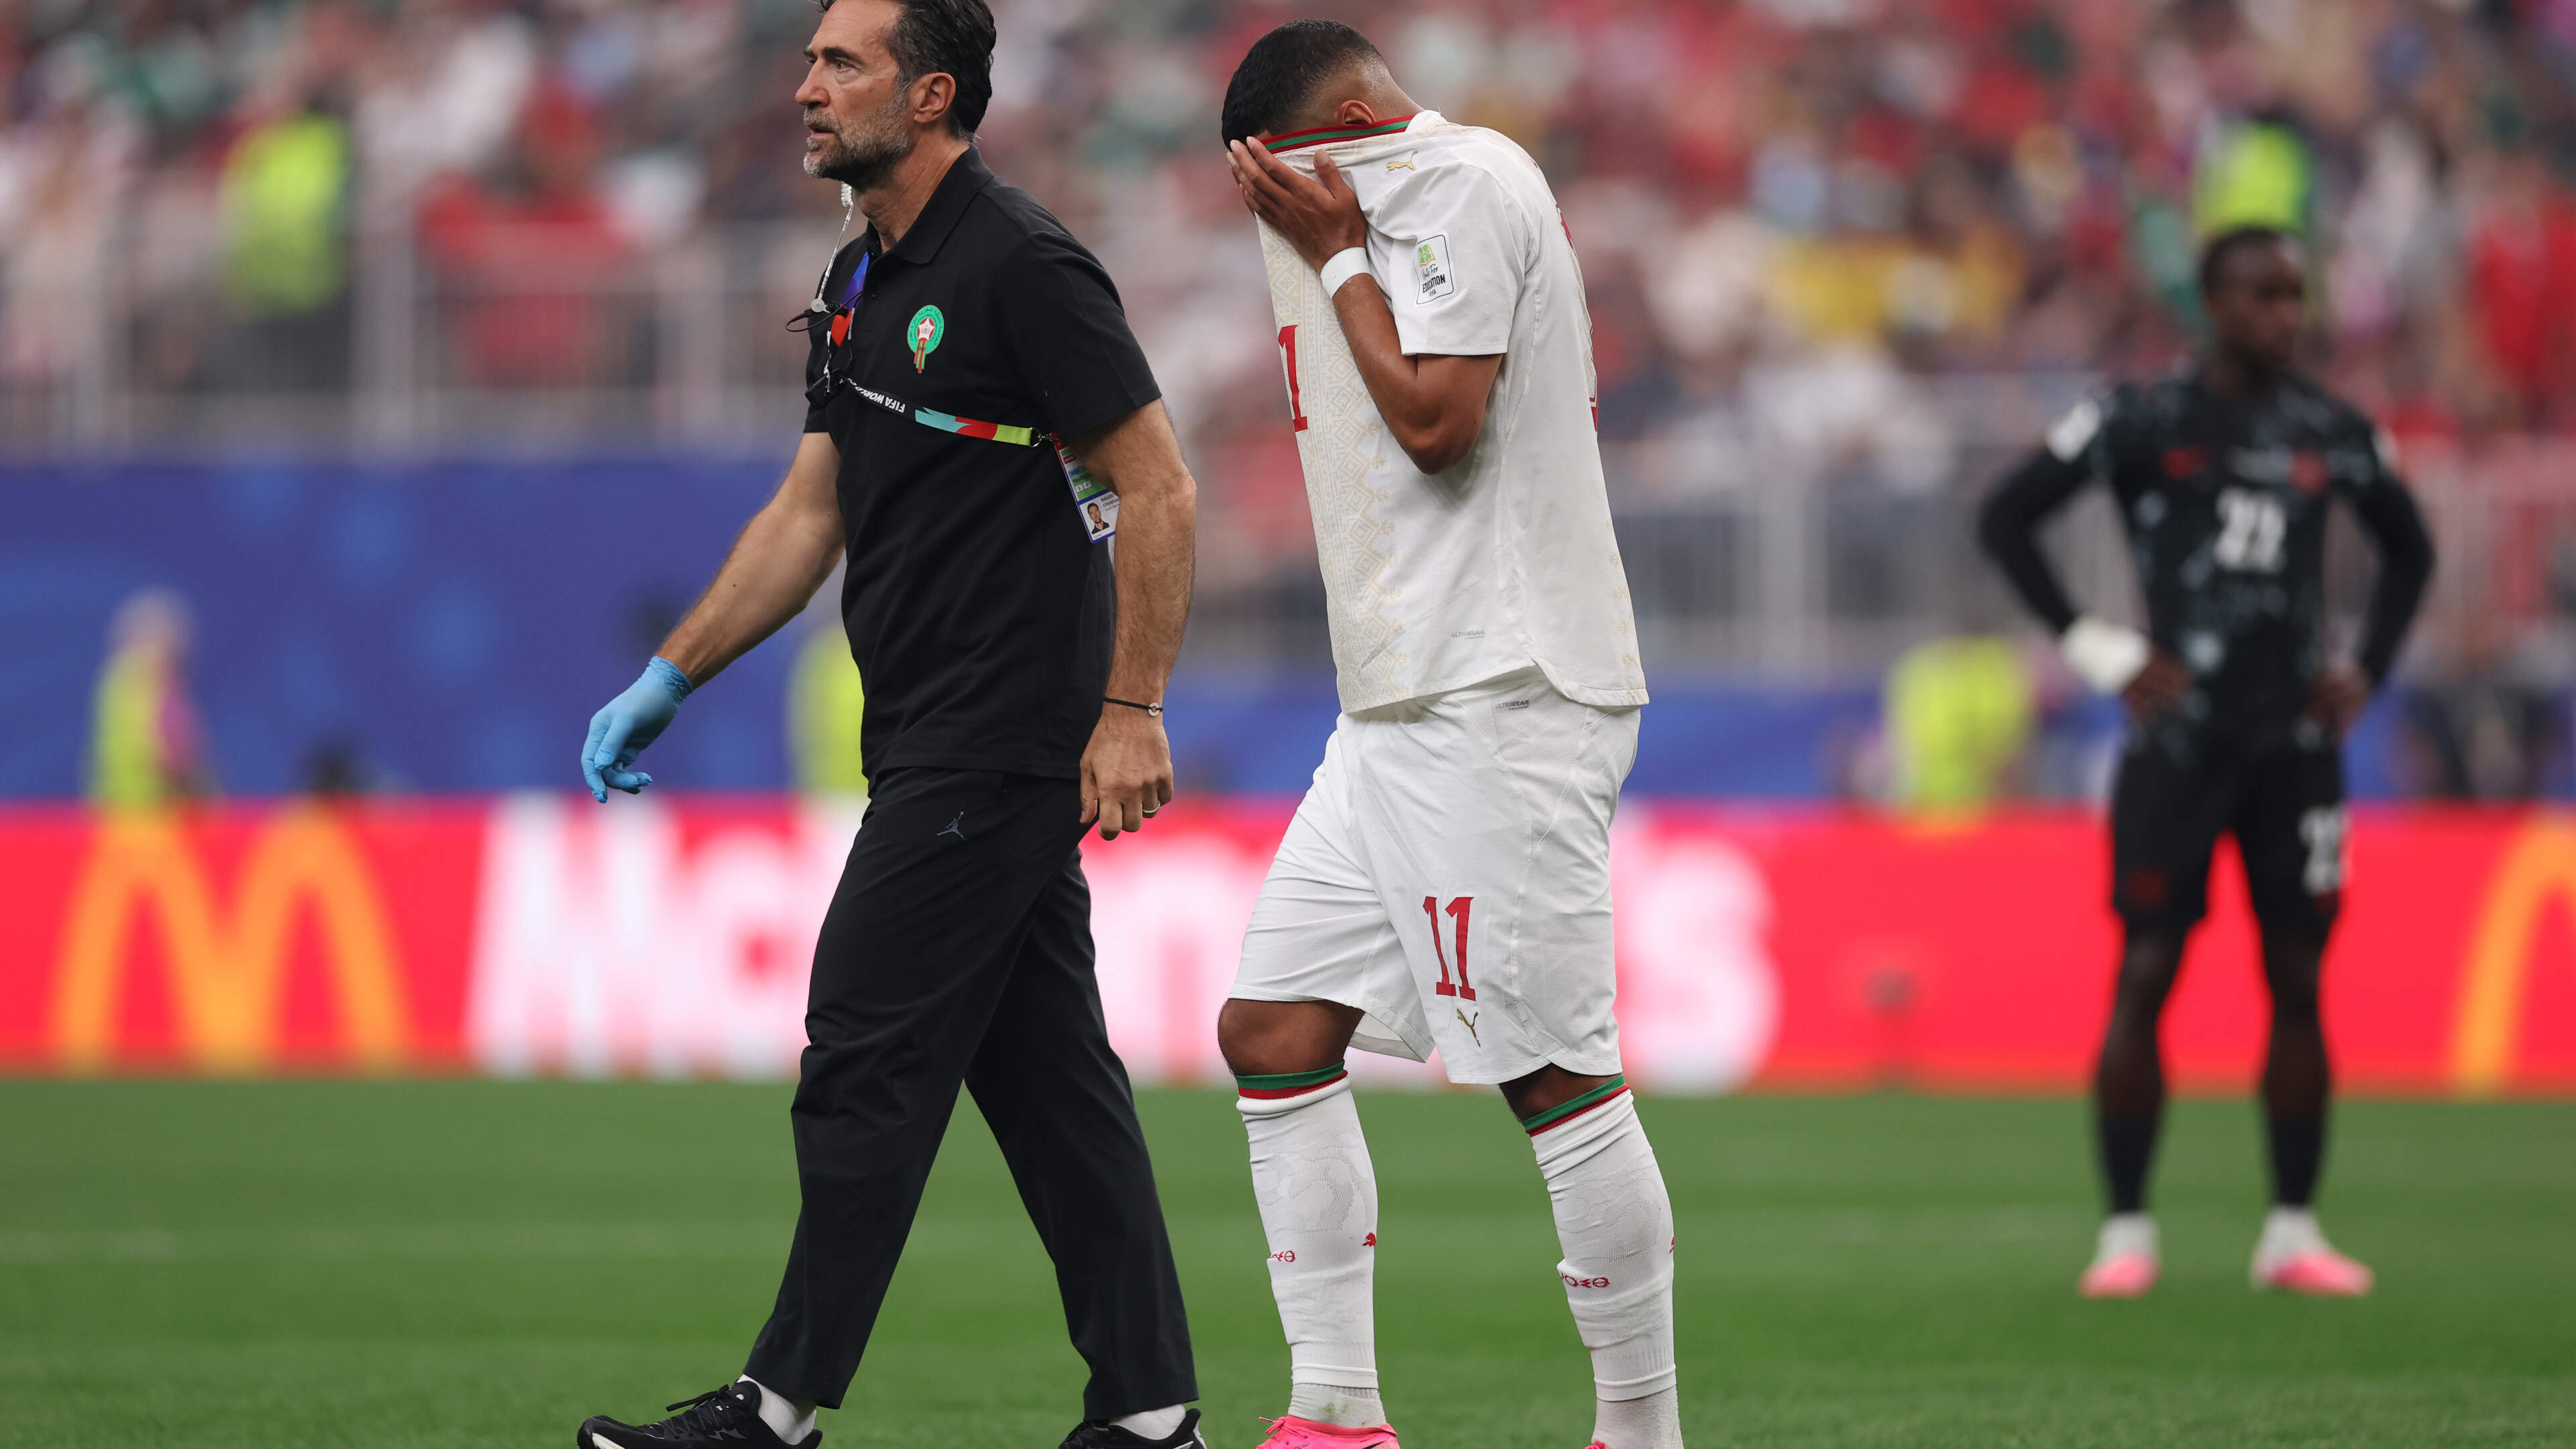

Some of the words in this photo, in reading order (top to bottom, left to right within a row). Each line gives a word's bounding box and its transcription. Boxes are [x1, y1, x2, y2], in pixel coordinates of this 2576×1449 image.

[1422, 274, 1446, 293] EDUCATION
[855, 386, 885, 404] WORLD
[885, 396, 906, 413] FIFA
[1495, 699, 1529, 709] ULTRAWEAVE
[1423, 896, 1477, 1002] 11
